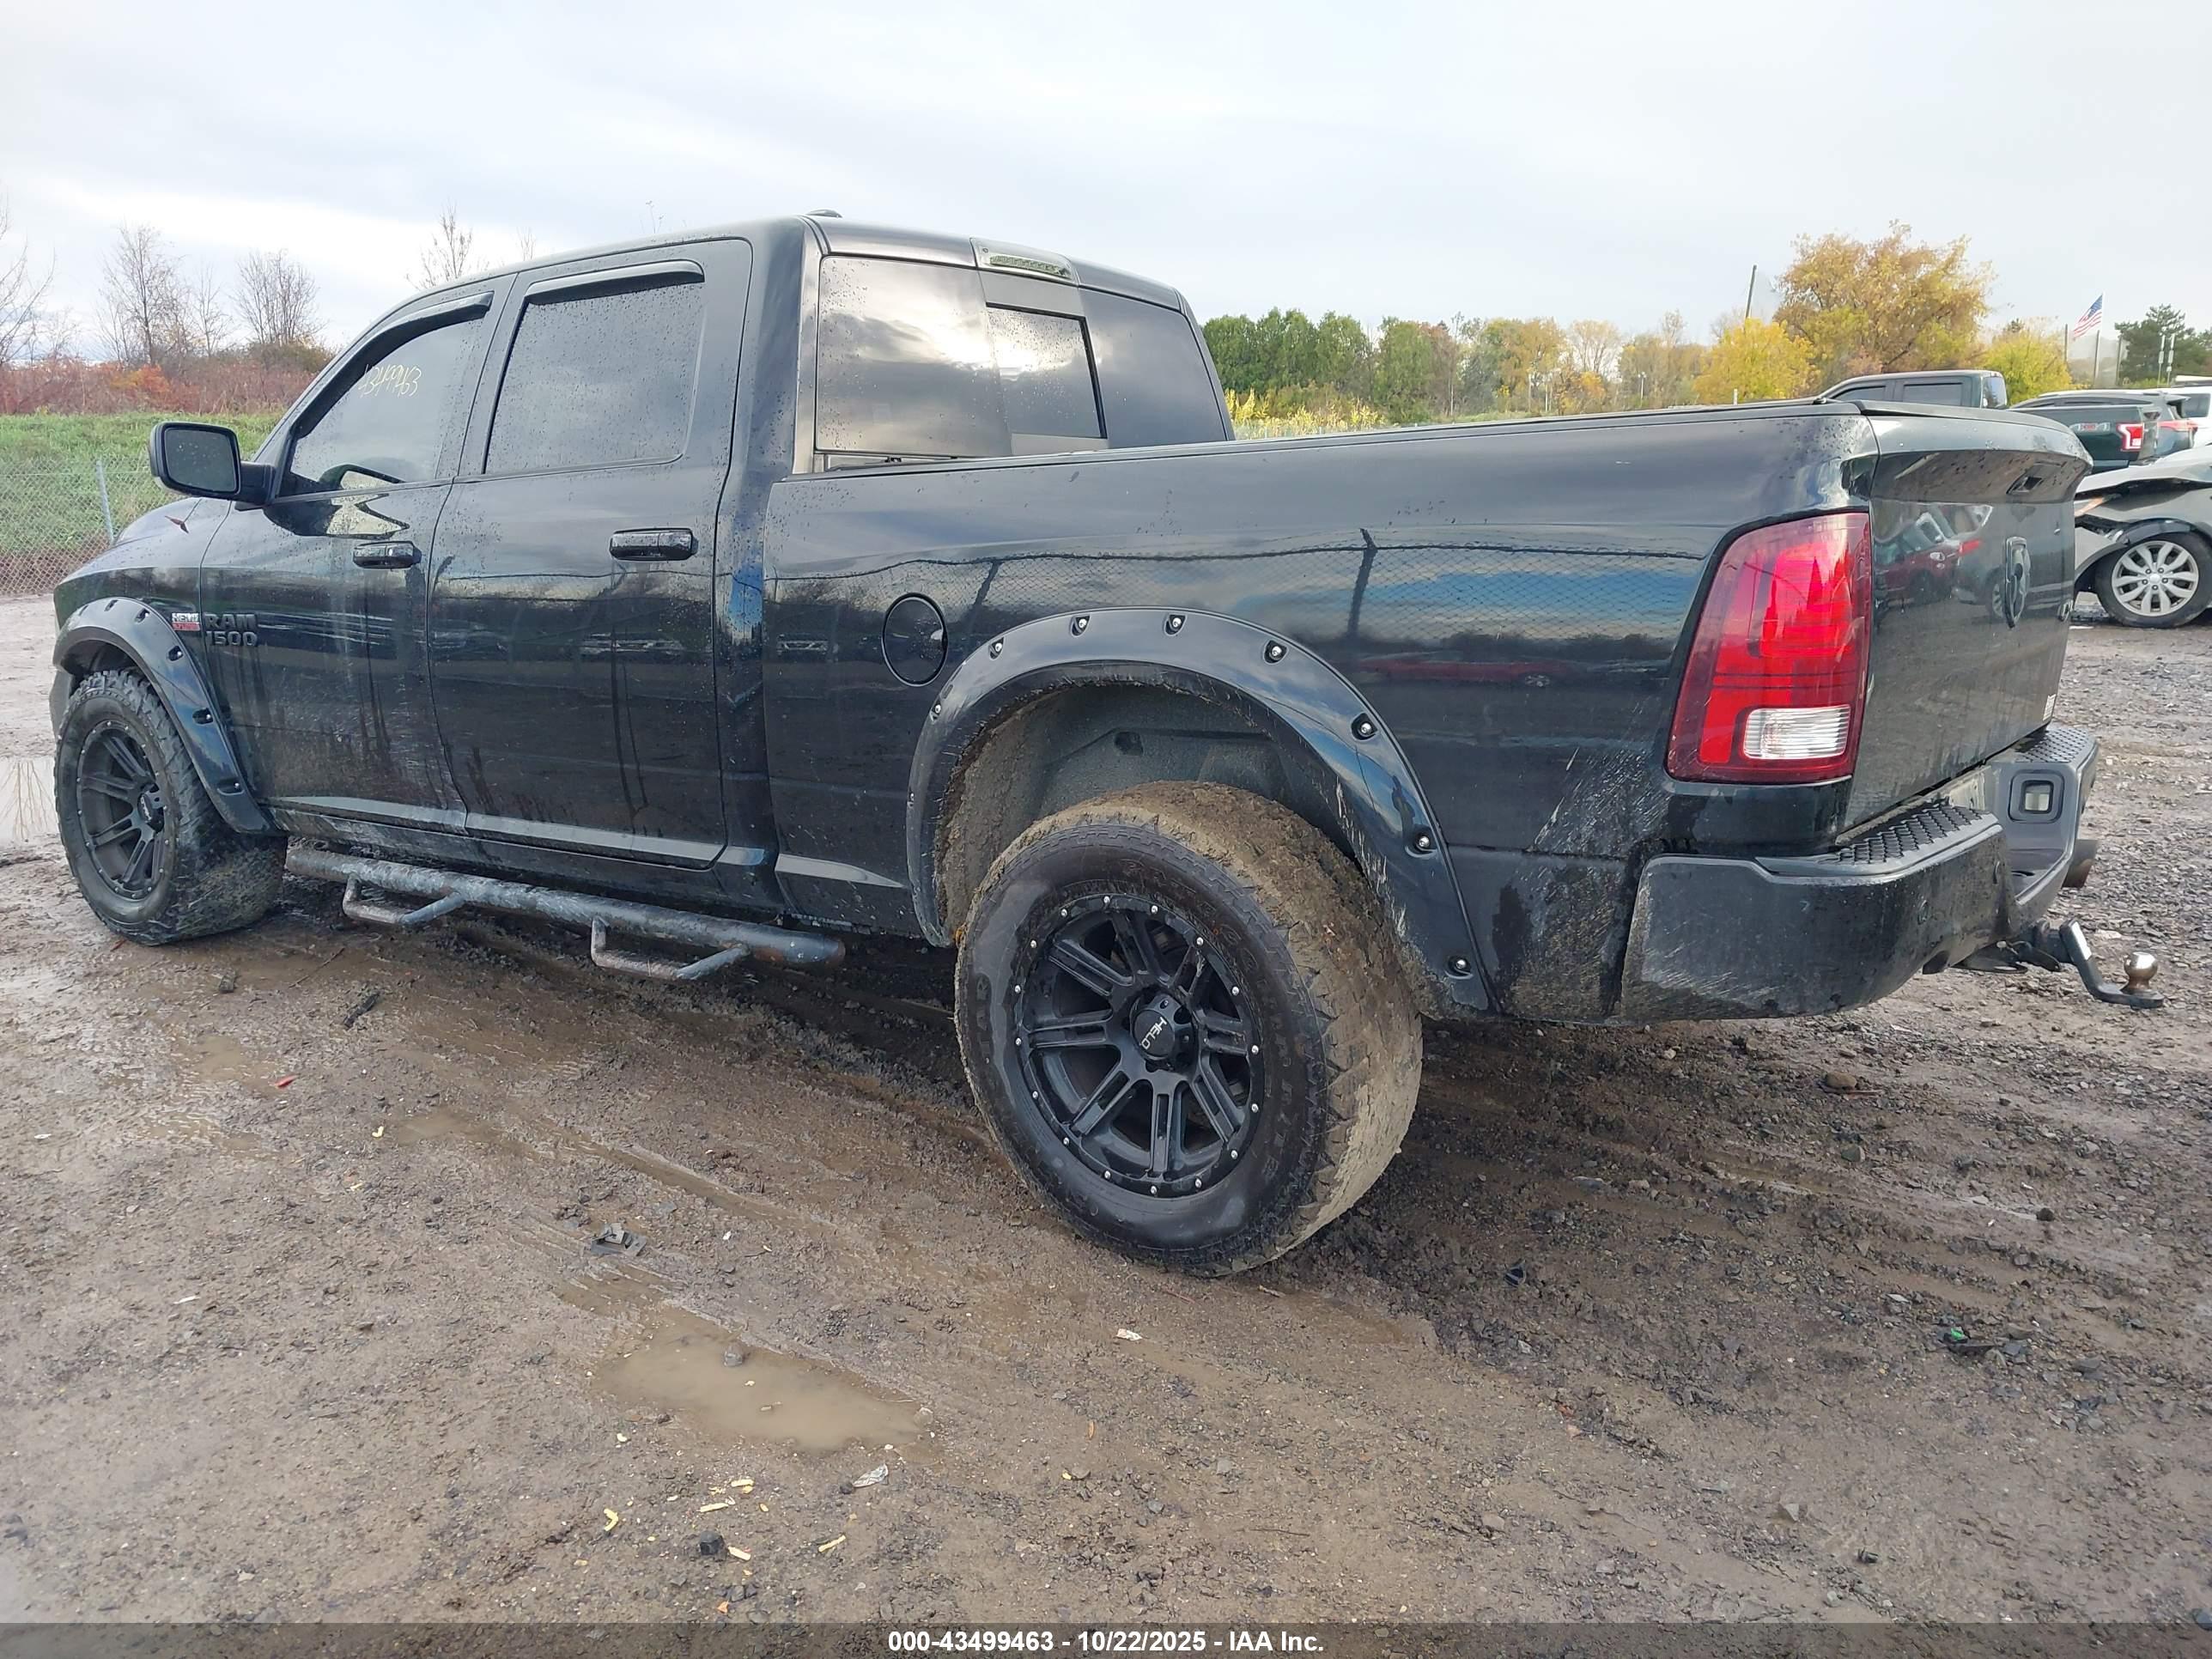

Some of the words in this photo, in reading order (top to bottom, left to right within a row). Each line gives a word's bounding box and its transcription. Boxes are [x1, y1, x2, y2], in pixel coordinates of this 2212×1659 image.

[204, 612, 257, 629] RAM
[205, 630, 258, 646] 1500
[1139, 1016, 1168, 1050] HELO
